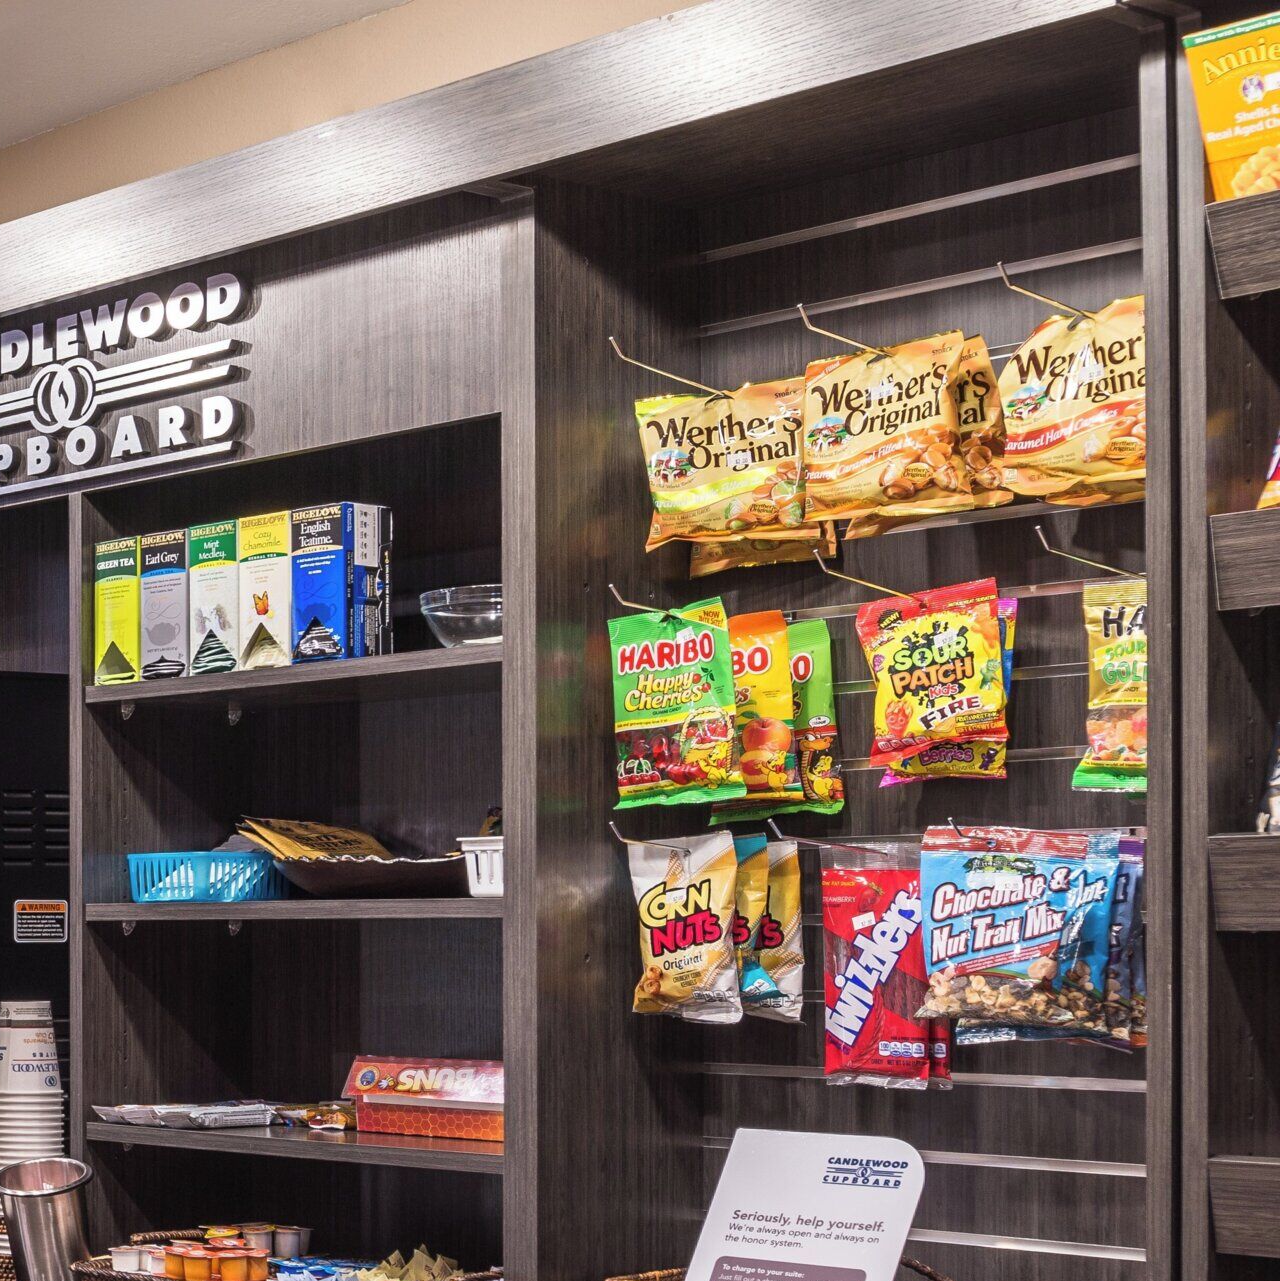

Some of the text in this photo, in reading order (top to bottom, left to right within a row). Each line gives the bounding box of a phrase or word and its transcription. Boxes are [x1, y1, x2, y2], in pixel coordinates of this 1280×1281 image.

[1233, 121, 1264, 137] Aged
[811, 362, 948, 415] Werther's
[845, 388, 941, 437] Original
[647, 408, 802, 449] Werther's
[1046, 423, 1072, 443] Hard
[688, 432, 797, 472] Original
[241, 514, 286, 528] BIGELOW
[292, 507, 341, 521] BIGELOW
[190, 523, 234, 536] BIGELOW
[253, 531, 272, 540] Cozy
[300, 520, 331, 535] English
[96, 539, 136, 553] BIGELOW
[141, 532, 184, 546] BIGELOW
[204, 540, 219, 549] Mint
[243, 538, 281, 551] Chamomile
[299, 535, 333, 547] Teatime
[145, 552, 179, 565] Earl Grey
[199, 549, 225, 561] Medley
[97, 558, 135, 570] GREEN TEA
[881, 613, 900, 629] NEW!
[619, 631, 715, 675] HARIBO
[895, 635, 968, 671] SOUR
[638, 671, 694, 695] Happy
[892, 657, 974, 695] PATCH
[624, 682, 703, 712] Cherries
[929, 683, 958, 698] Kids
[920, 696, 982, 731] FIRE
[920, 747, 973, 765] Berries
[931, 867, 1071, 922] Chocolate &
[29, 903, 60, 911] WARNING
[639, 879, 711, 928] CORN
[651, 911, 722, 957] NUTS
[931, 924, 969, 965] Nut
[972, 915, 1022, 951] Trail
[1024, 902, 1066, 939] Mix
[663, 954, 702, 971] Original
[396, 1067, 476, 1093] BUNS
[828, 1157, 909, 1169] CANDLEWOOD
[823, 1175, 902, 1187] CUPBOARD
[732, 1210, 885, 1232] Seriously, help yourself.
[729, 1222, 880, 1244] We're always open and always on
[725, 1234, 803, 1249] the honor system.
[732, 1264, 755, 1274] charge
[767, 1269, 782, 1277] your
